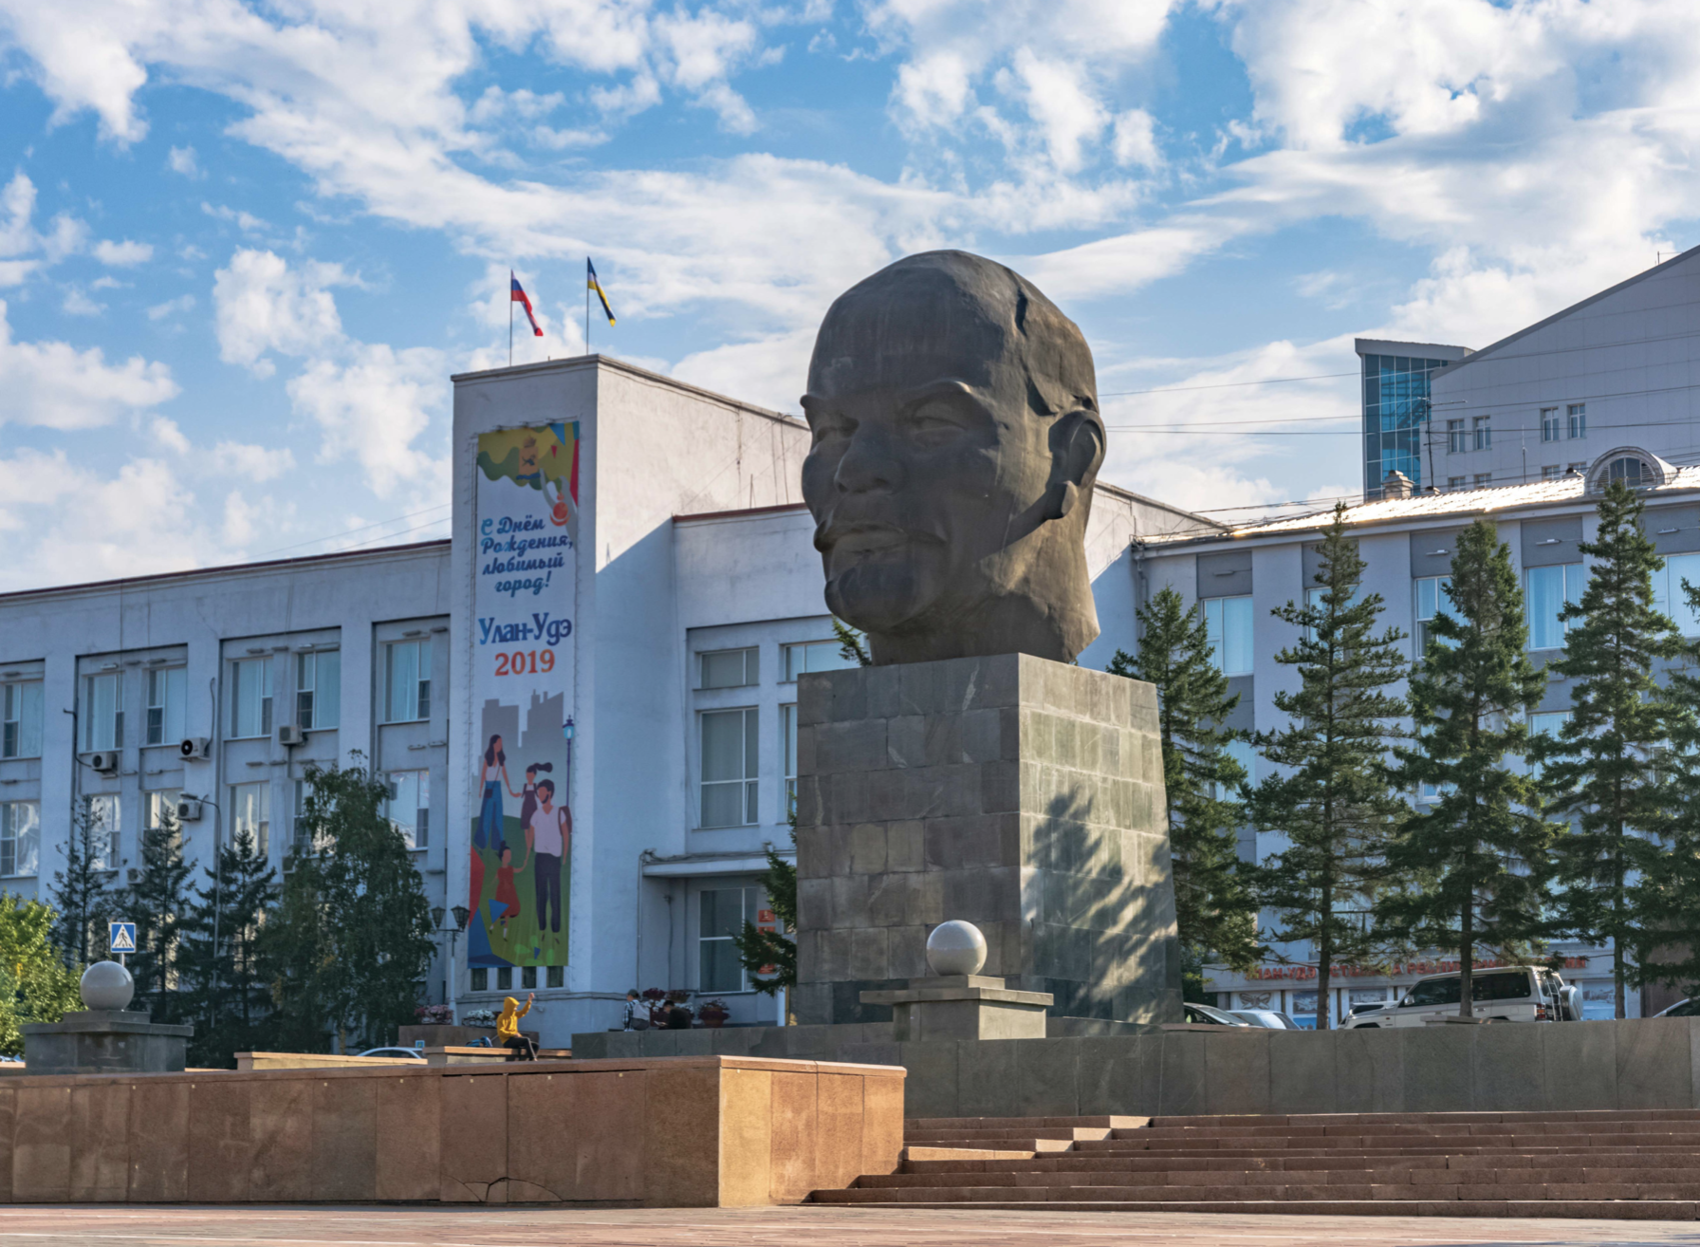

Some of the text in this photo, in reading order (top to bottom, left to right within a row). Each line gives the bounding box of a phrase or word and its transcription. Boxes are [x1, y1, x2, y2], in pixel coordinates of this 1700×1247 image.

[480, 514, 546, 536] С Днём
[480, 535, 573, 557] Рождения,
[482, 552, 565, 575] любимый
[495, 571, 552, 598] город!
[478, 612, 572, 646] Улан-Удэ
[495, 649, 555, 677] 2019
[1329, 962, 1402, 978] СТОА
[1407, 959, 1510, 975] РЕСПУИКИ
